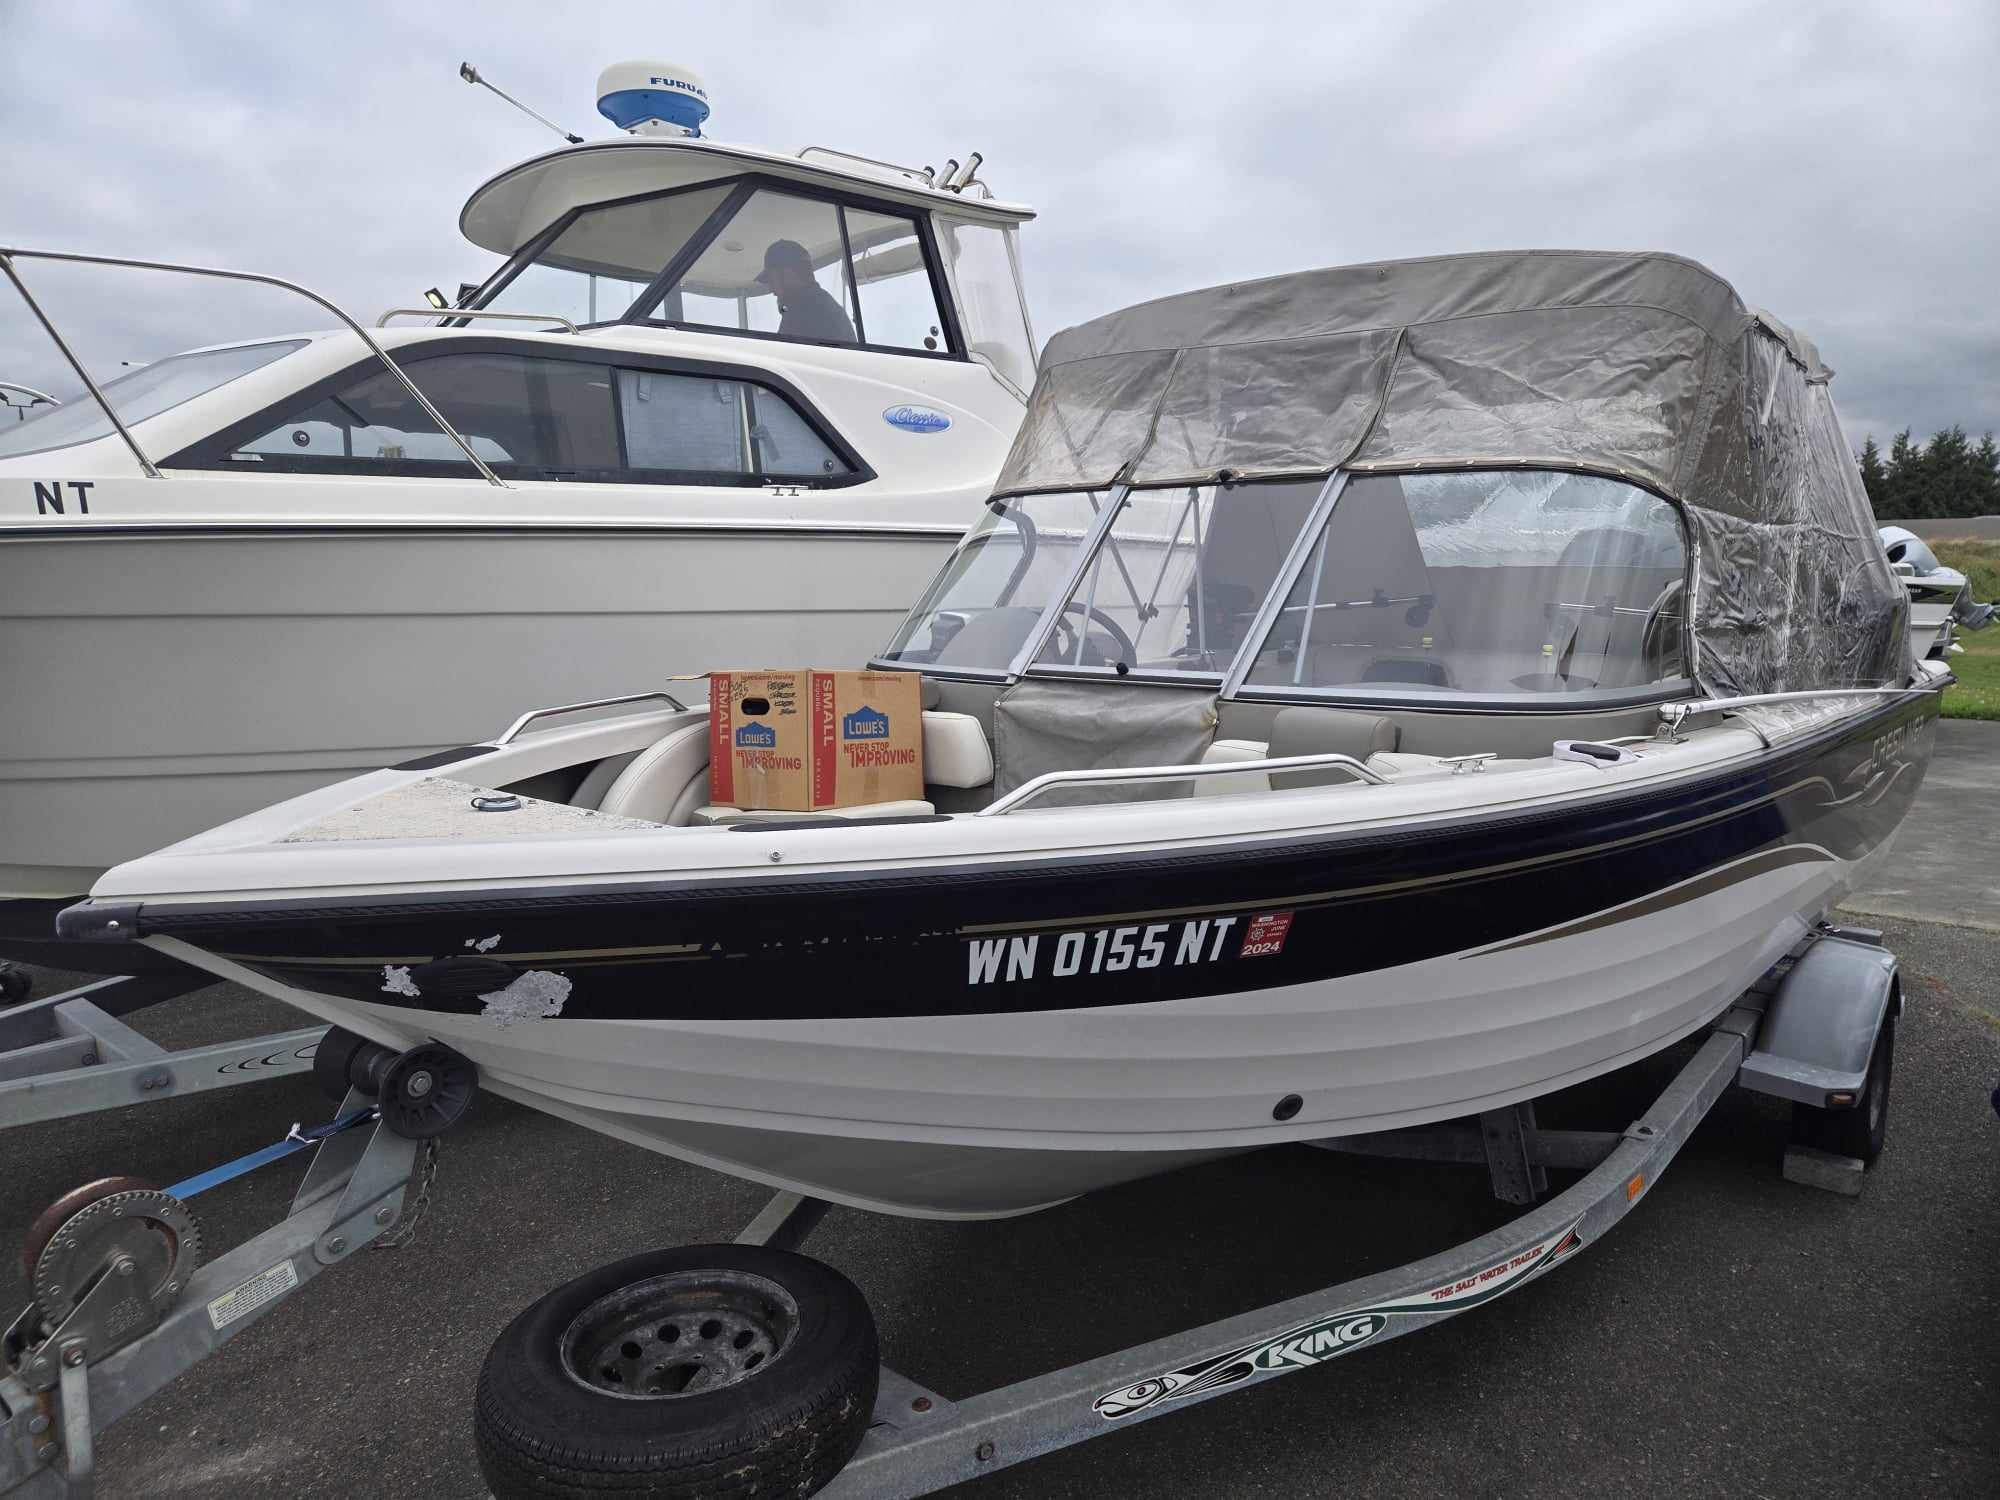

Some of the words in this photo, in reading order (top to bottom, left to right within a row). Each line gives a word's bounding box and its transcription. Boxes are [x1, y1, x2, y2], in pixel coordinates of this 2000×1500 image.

[895, 406, 939, 425] Classic
[33, 481, 94, 515] NT
[719, 679, 730, 745] SMALL
[822, 679, 835, 747] SMALL
[848, 719, 886, 736] LOWE'S
[843, 742, 870, 754] NEVER
[871, 741, 890, 752] STOP
[850, 748, 916, 769] IMPROVING
[742, 756, 802, 770] IMPROVING
[968, 935, 1039, 985] WN
[1052, 924, 1170, 977] 0155
[1174, 917, 1238, 966] NT
[1241, 941, 1281, 956] 2024
[1455, 1276, 1479, 1293] SALT
[1479, 1263, 1509, 1282] WATER
[1268, 1315, 1373, 1368] KING
